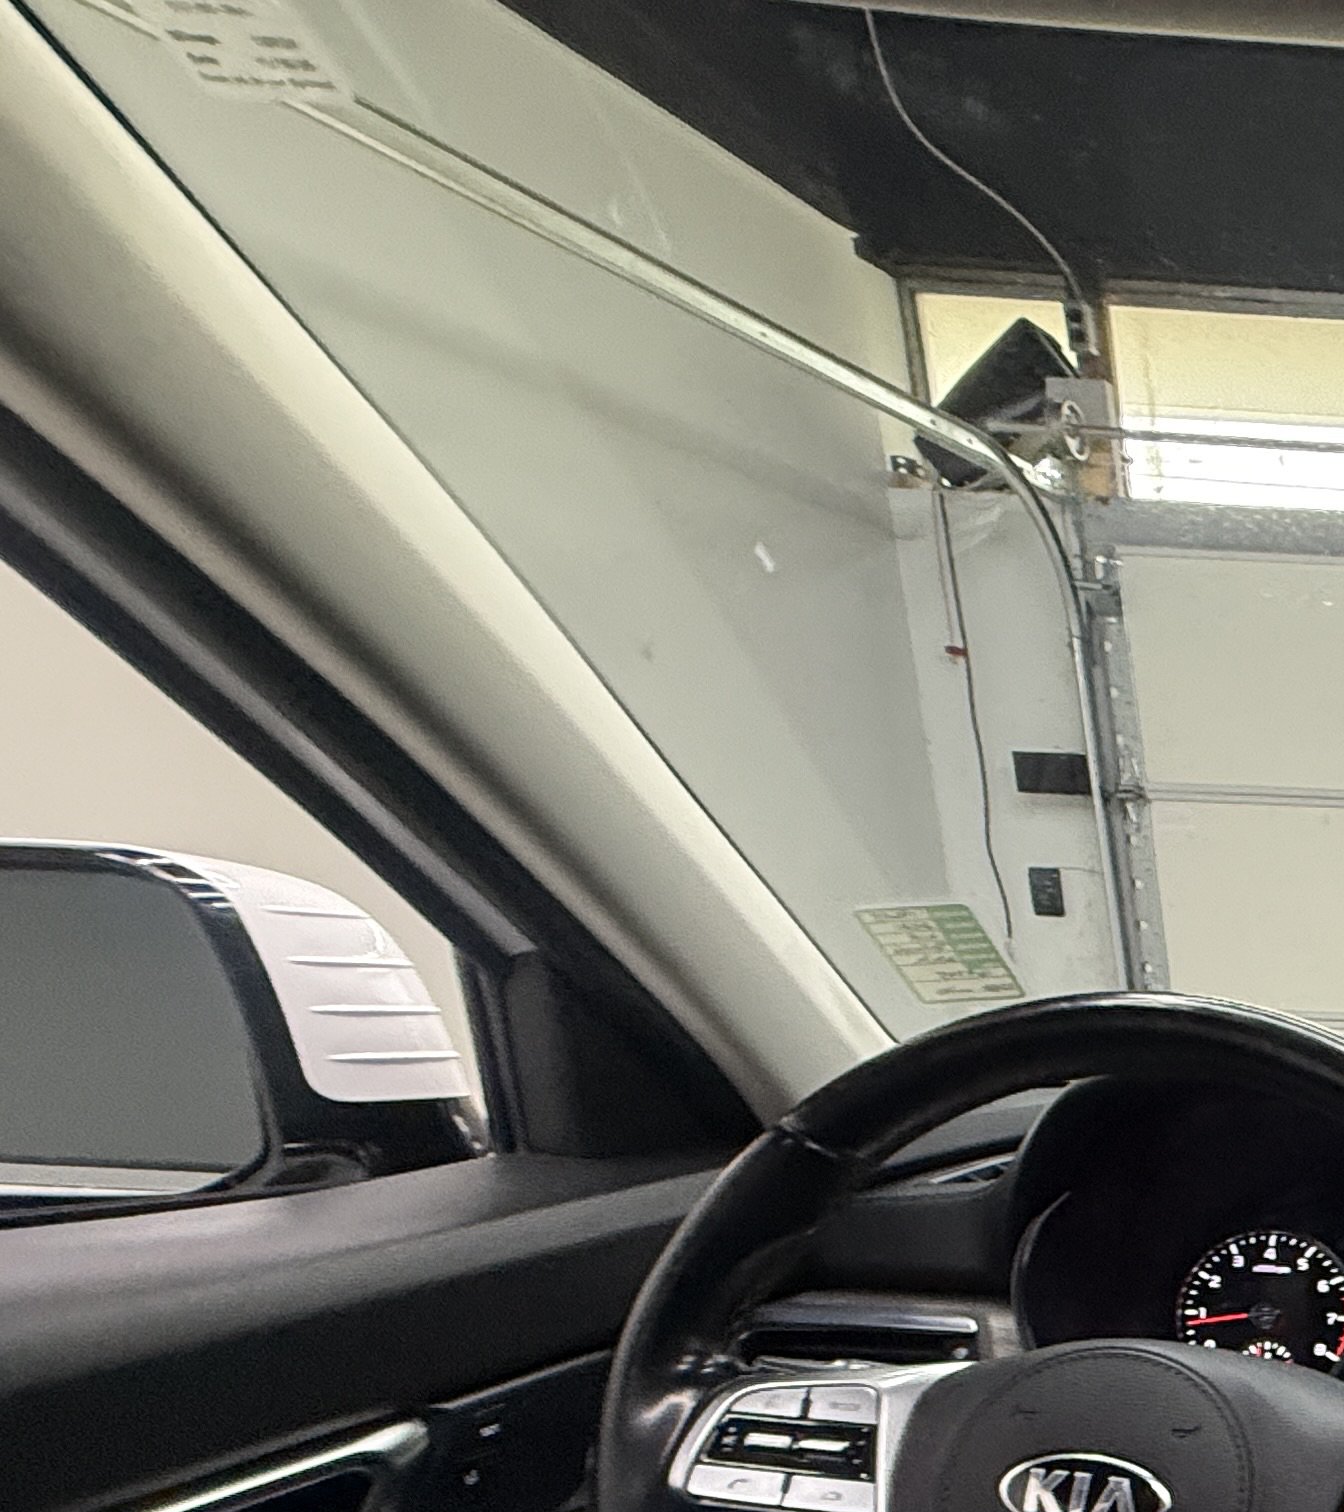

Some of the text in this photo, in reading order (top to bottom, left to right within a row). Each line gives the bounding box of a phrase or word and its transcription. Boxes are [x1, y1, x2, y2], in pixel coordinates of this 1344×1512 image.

[1232, 1255, 1245, 1268] 3
[1296, 1257, 1309, 1271] 5
[1208, 1275, 1222, 1288] 2
[1316, 1279, 1330, 1293] 6
[1326, 1312, 1338, 1325] 7
